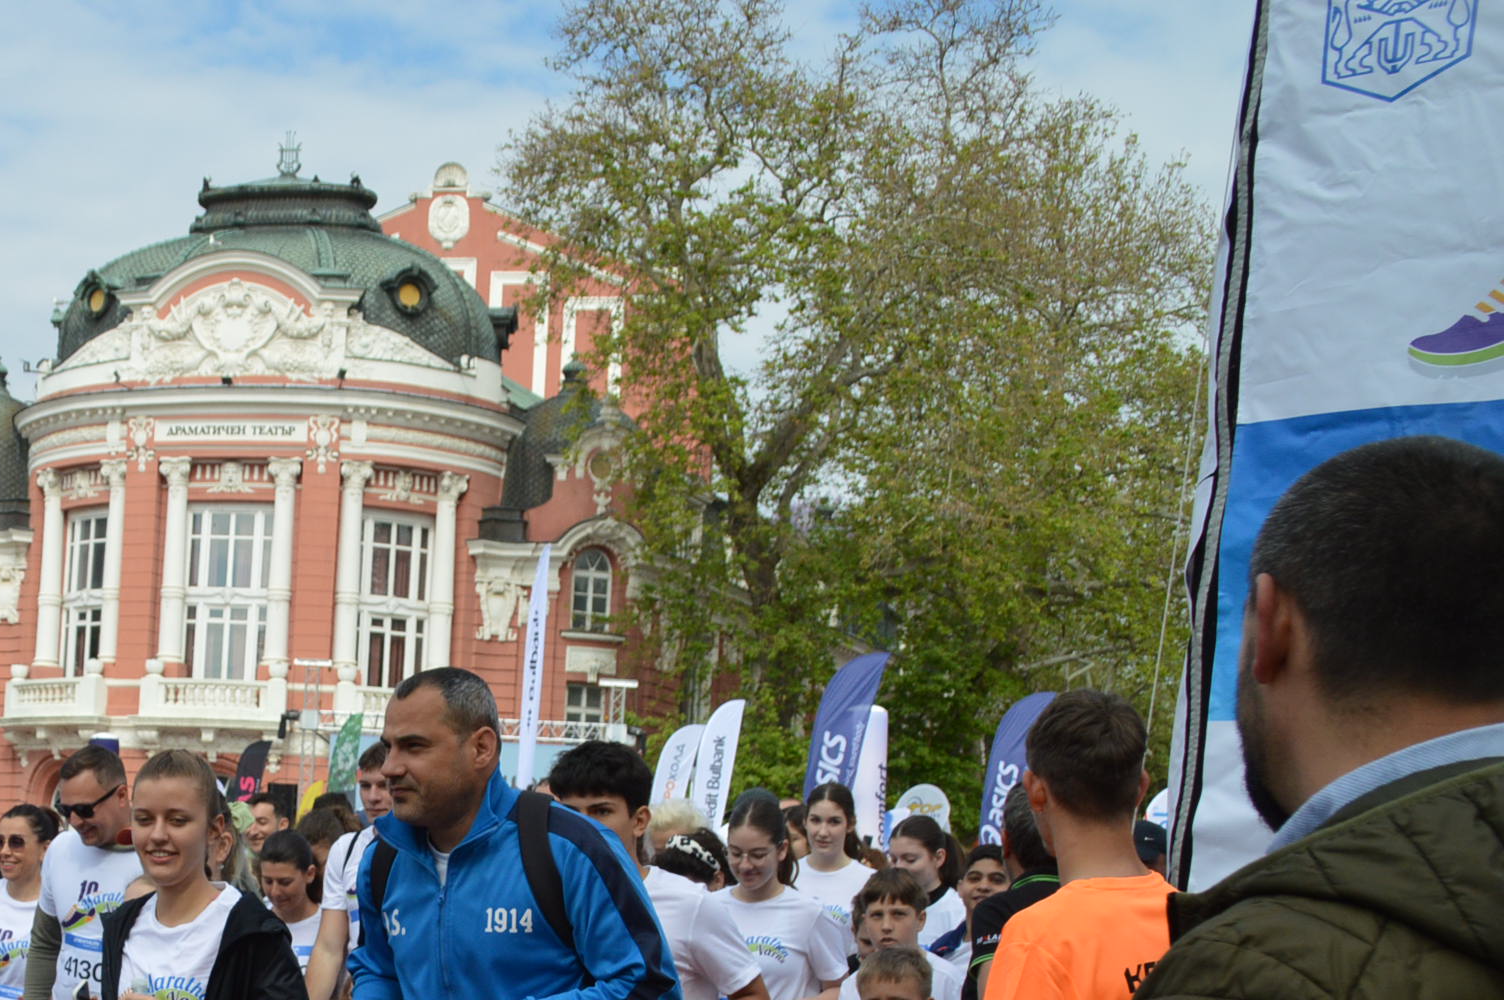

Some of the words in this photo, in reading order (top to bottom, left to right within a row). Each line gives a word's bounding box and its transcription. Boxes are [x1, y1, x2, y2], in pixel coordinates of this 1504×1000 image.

[166, 425, 247, 437] ДРАМАТИЧЕН
[251, 425, 297, 437] ТЕАТЪР
[706, 735, 726, 791] Bulbank
[485, 907, 534, 933] 1914
